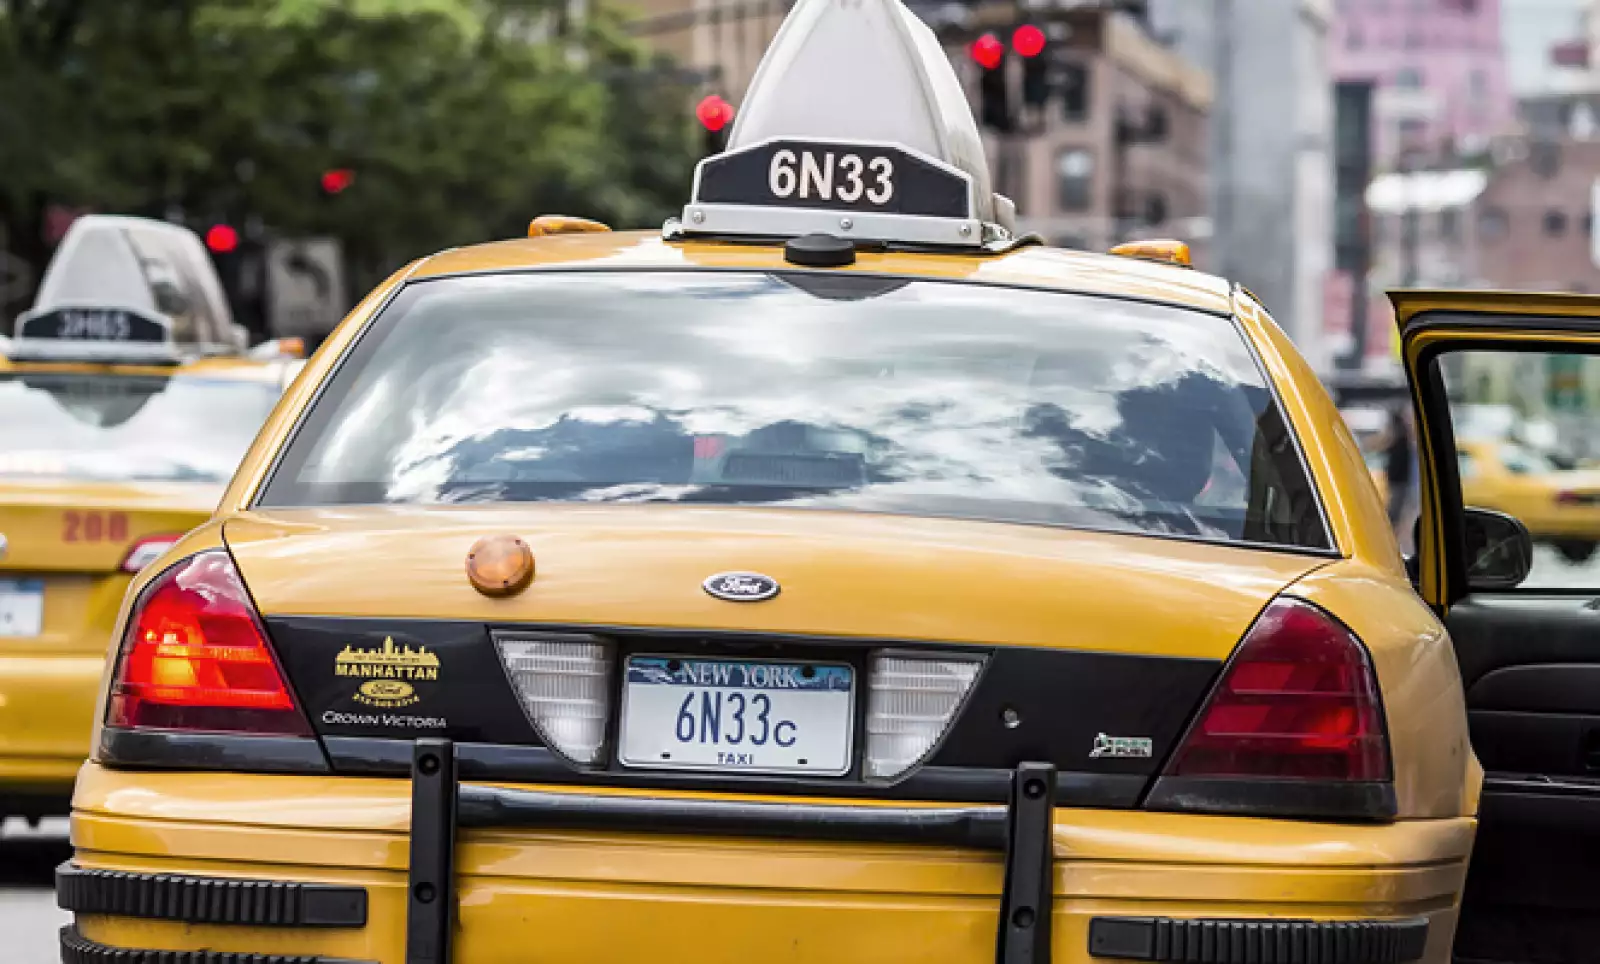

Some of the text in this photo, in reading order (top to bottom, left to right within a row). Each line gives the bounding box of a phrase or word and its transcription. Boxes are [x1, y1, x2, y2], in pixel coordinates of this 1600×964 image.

[769, 149, 894, 206] 6N33
[719, 576, 762, 594] Ford
[335, 663, 438, 681] MANHATTAN
[680, 662, 799, 688] NEW YORK
[322, 710, 447, 729] CROWN VICTORIA
[717, 752, 754, 765] TAXI
